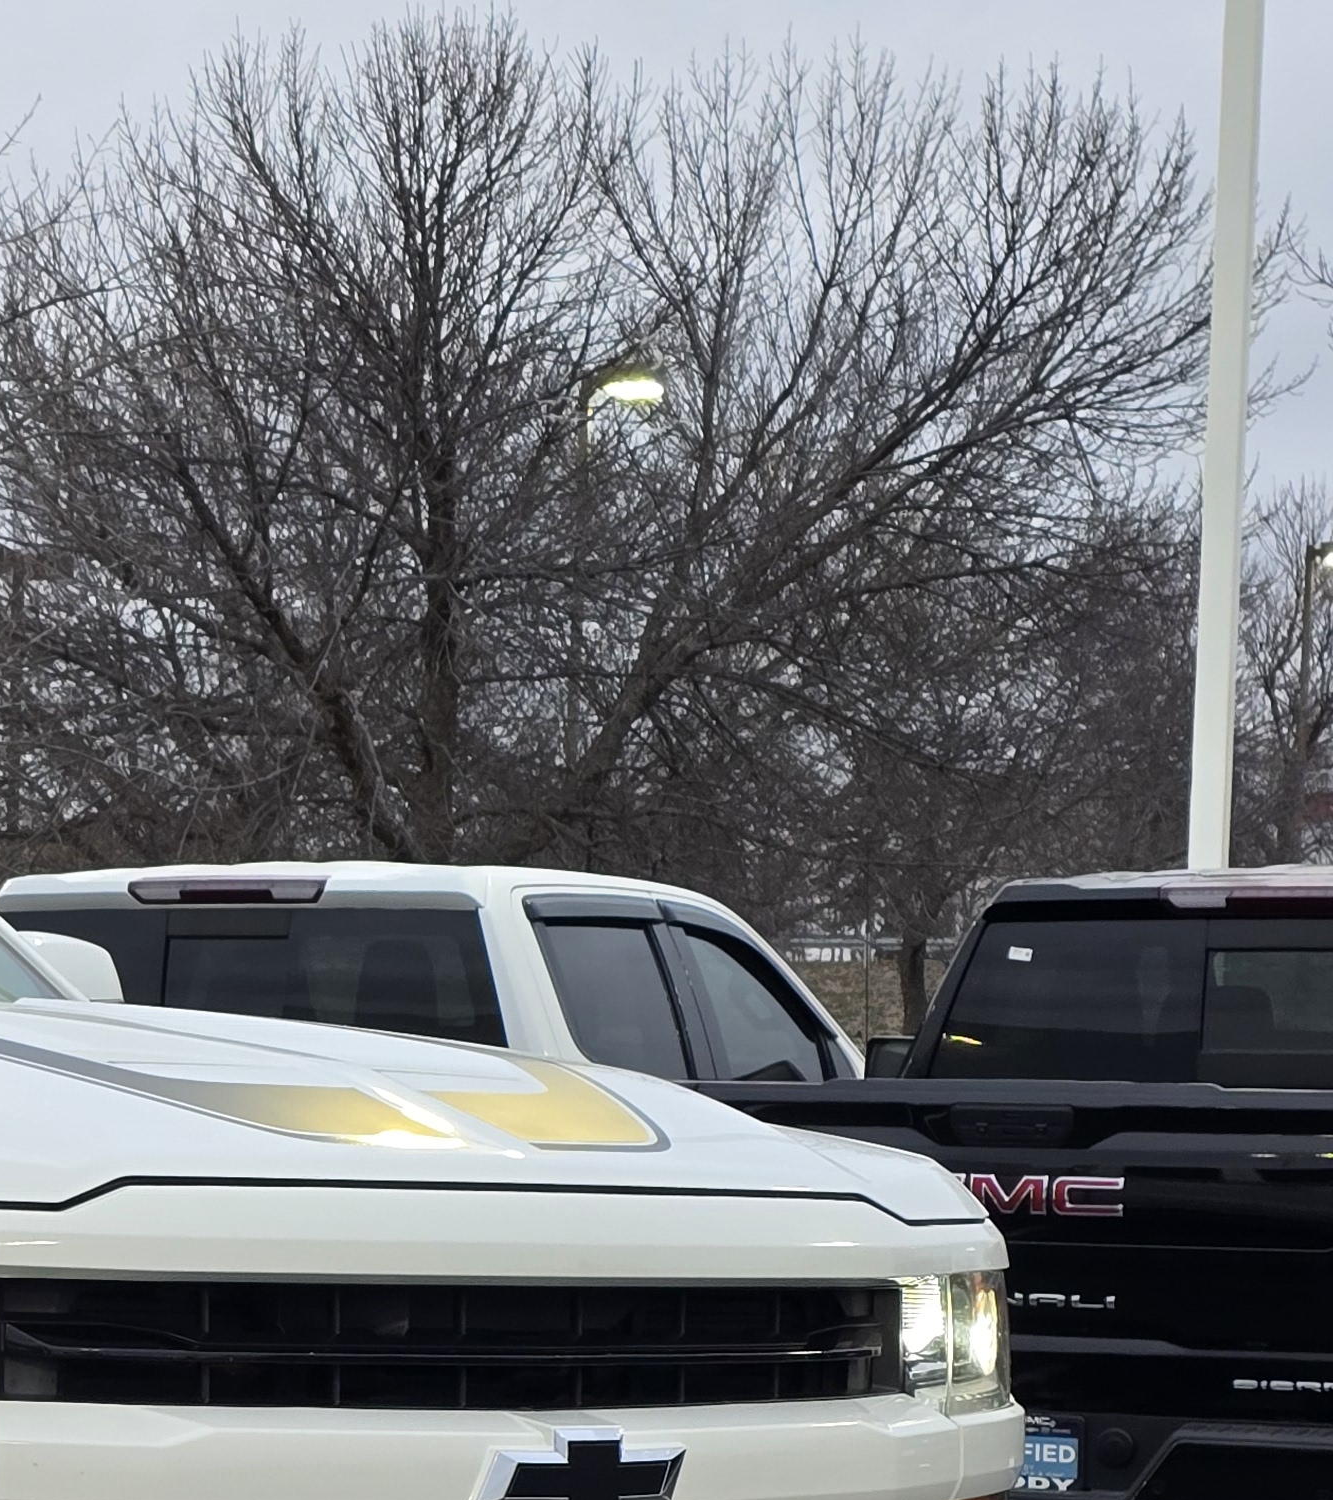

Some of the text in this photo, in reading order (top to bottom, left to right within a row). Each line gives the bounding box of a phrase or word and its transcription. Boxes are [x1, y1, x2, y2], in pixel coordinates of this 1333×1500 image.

[955, 1173, 1126, 1217] MC
[1025, 1443, 1077, 1463] FIED
[1014, 1476, 1075, 1491] DY
